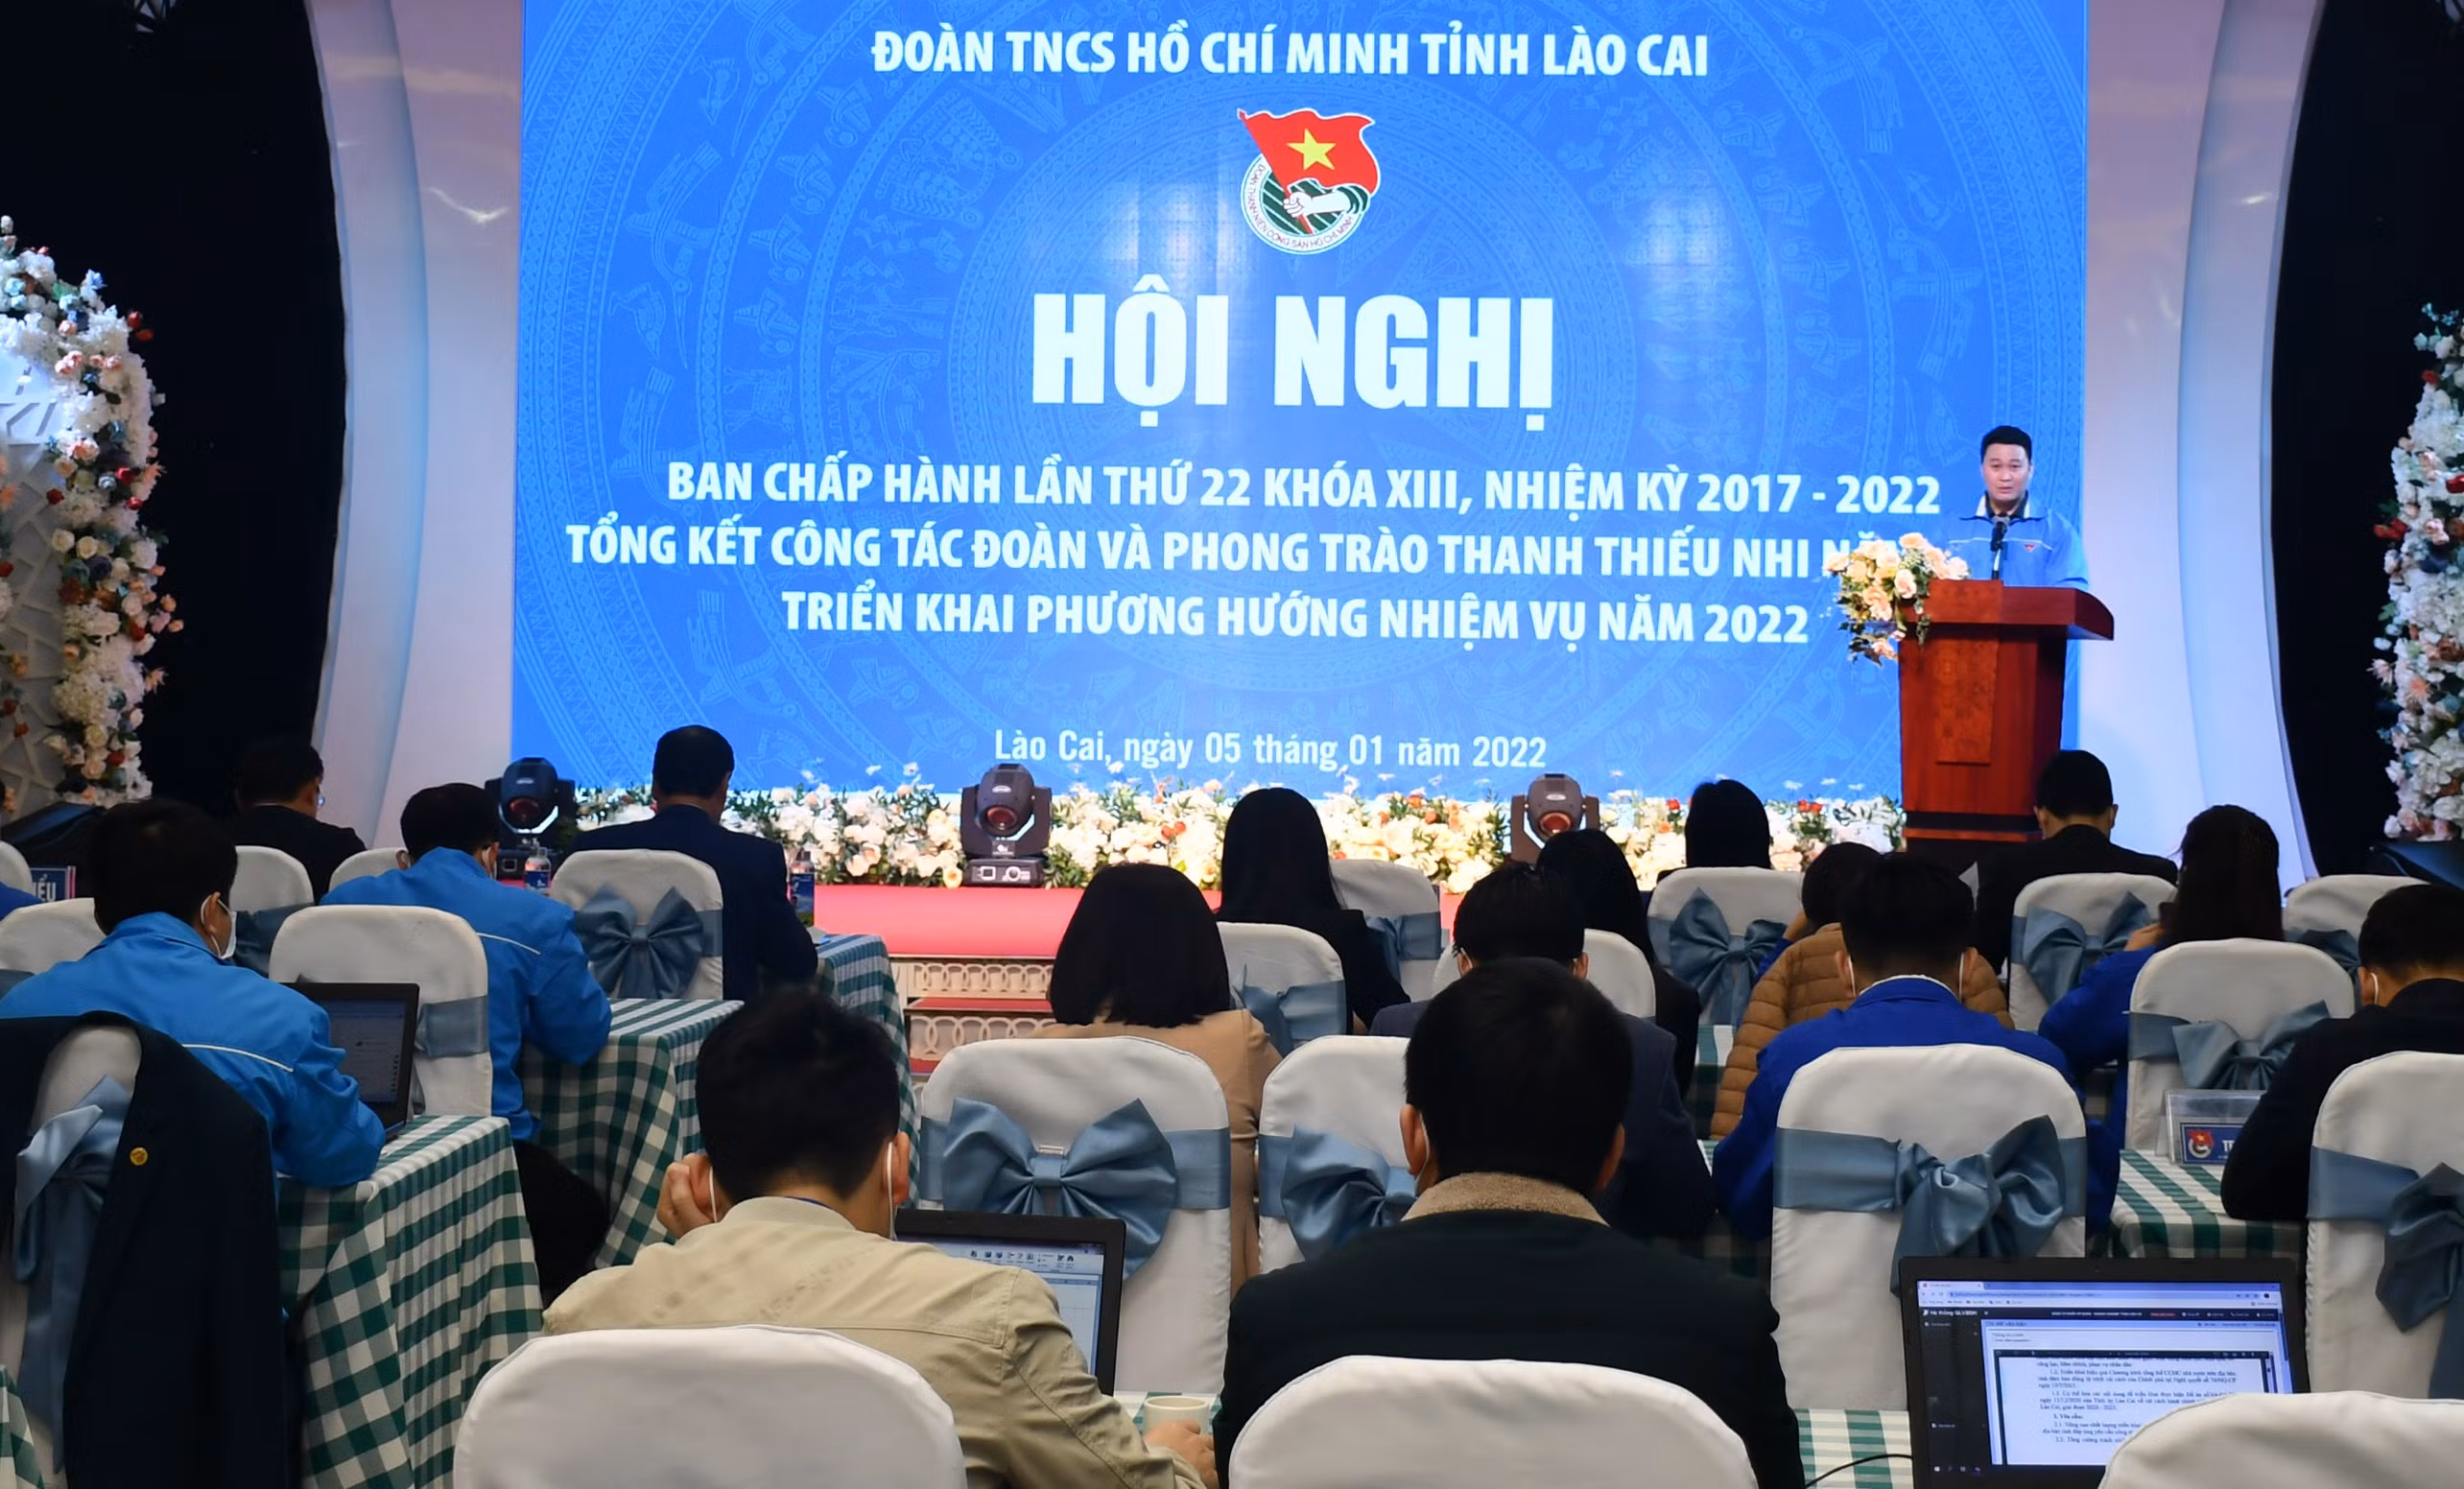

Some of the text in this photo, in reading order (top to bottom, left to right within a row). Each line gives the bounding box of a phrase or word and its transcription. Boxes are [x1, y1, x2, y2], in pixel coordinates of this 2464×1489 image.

[872, 19, 1707, 76] ĐOÀN TNCS HỒ CHÍ MINH TỈNH LÀO CAI
[1033, 273, 1553, 431] HỘI NGHỊ
[669, 451, 1940, 522] BAN CHẤP HÀNH LẦN THỨ 22 KHÓA XIII, NHIỆM KỲ 2017 - 2022
[566, 511, 676, 564] TỔNG
[689, 514, 762, 564] KẾT
[770, 519, 881, 567] CÔNG
[890, 521, 963, 567] TÁC
[971, 522, 1086, 569] ĐOÀN
[1097, 523, 1151, 570] VÀ
[1163, 532, 1309, 572] PHONG
[1319, 527, 1429, 573] TRÀO
[1437, 534, 1583, 576] THANH
[1594, 525, 1720, 577] THIẾU
[1734, 539, 1809, 578] NHI
[782, 579, 1808, 652] TRIỂN KHAI PHƯƠNG HƯỚNG NHIỆM VỤ NĂM 2022
[995, 729, 1547, 768] Lào Cai, ngày 05 tháng 01 năm 2022
